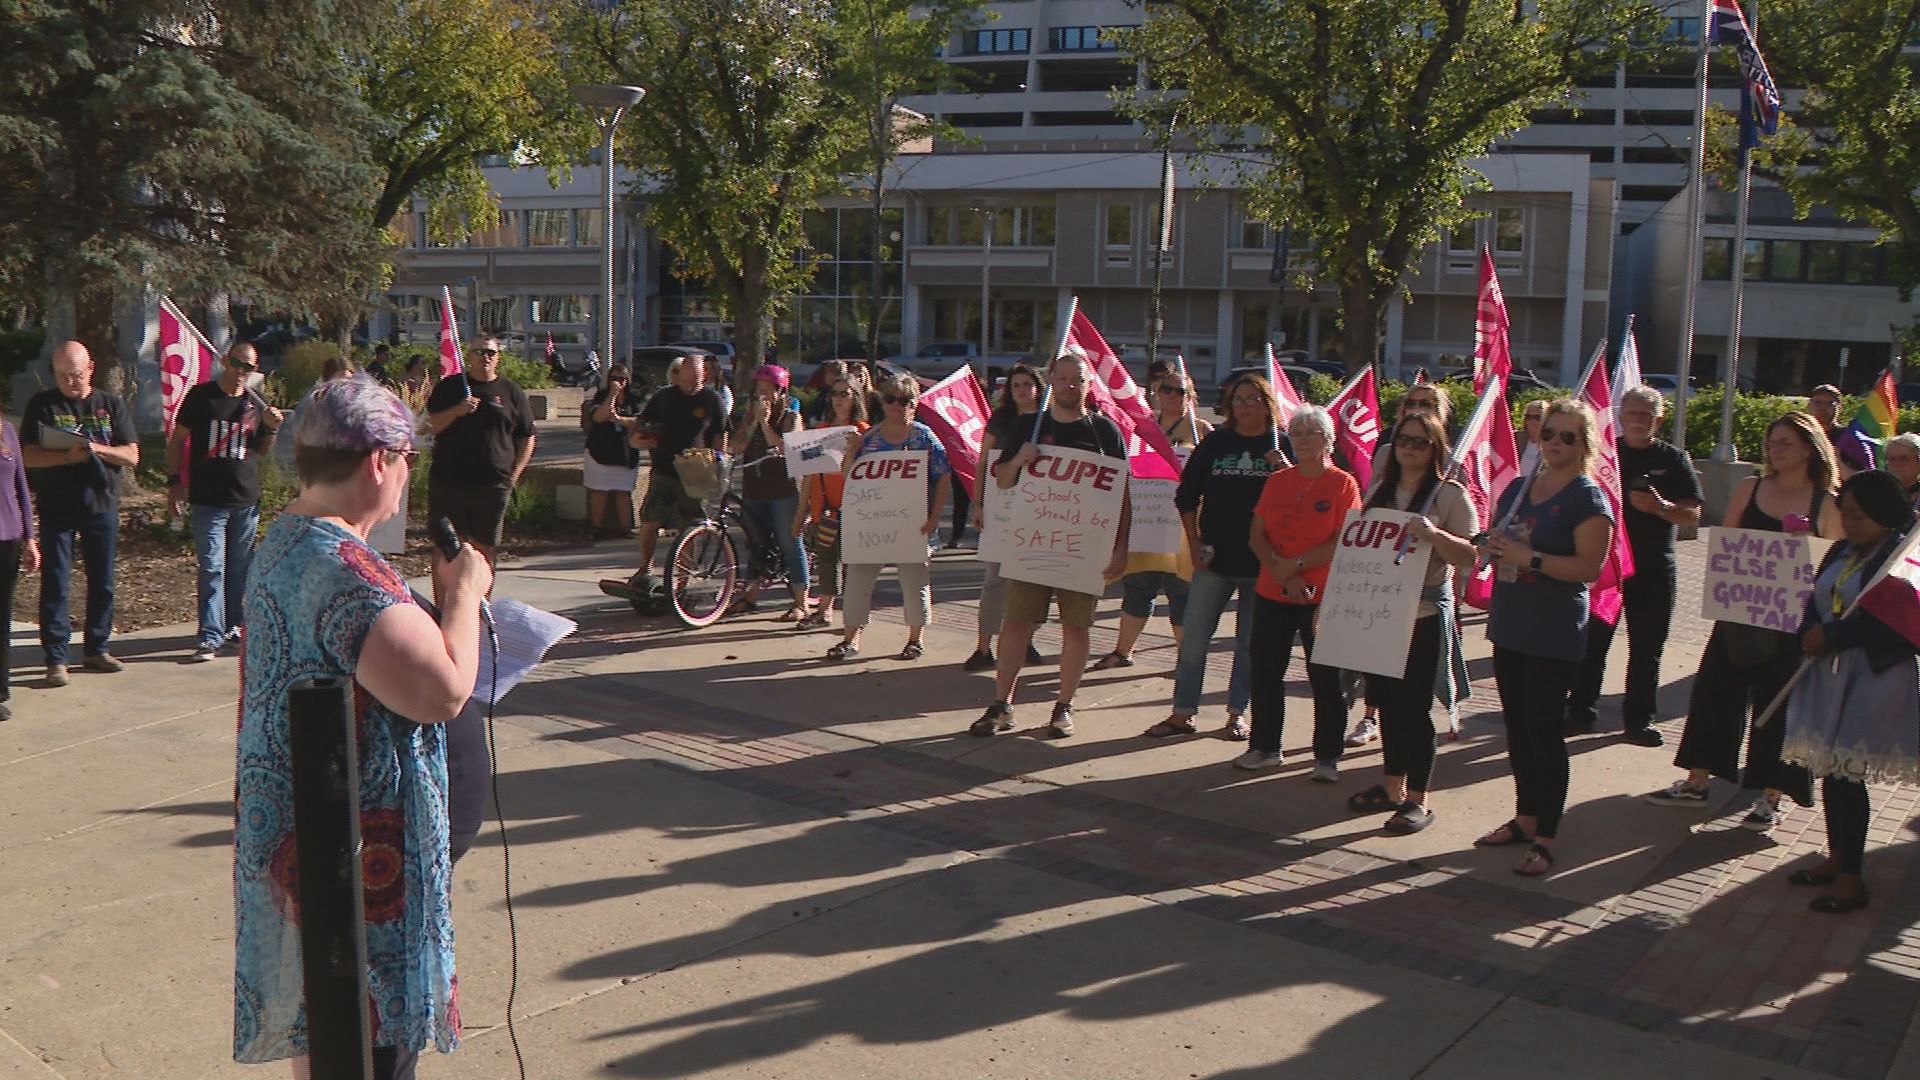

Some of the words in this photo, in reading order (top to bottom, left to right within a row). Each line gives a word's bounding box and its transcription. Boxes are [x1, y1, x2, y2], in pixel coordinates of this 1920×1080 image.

[851, 459, 920, 480] CUPE
[1027, 455, 1120, 491] CUPE
[850, 487, 883, 505] SAFE
[1020, 482, 1080, 504] Schools
[1034, 506, 1080, 525] should
[1090, 512, 1109, 528] be
[858, 530, 897, 548] NOW
[1014, 528, 1084, 552] SAFE
[1720, 533, 1801, 560] WHAT
[1710, 554, 1777, 580] ELSE
[1712, 581, 1788, 613] GOING
[1795, 590, 1813, 616] T
[1747, 606, 1798, 633] TAK
